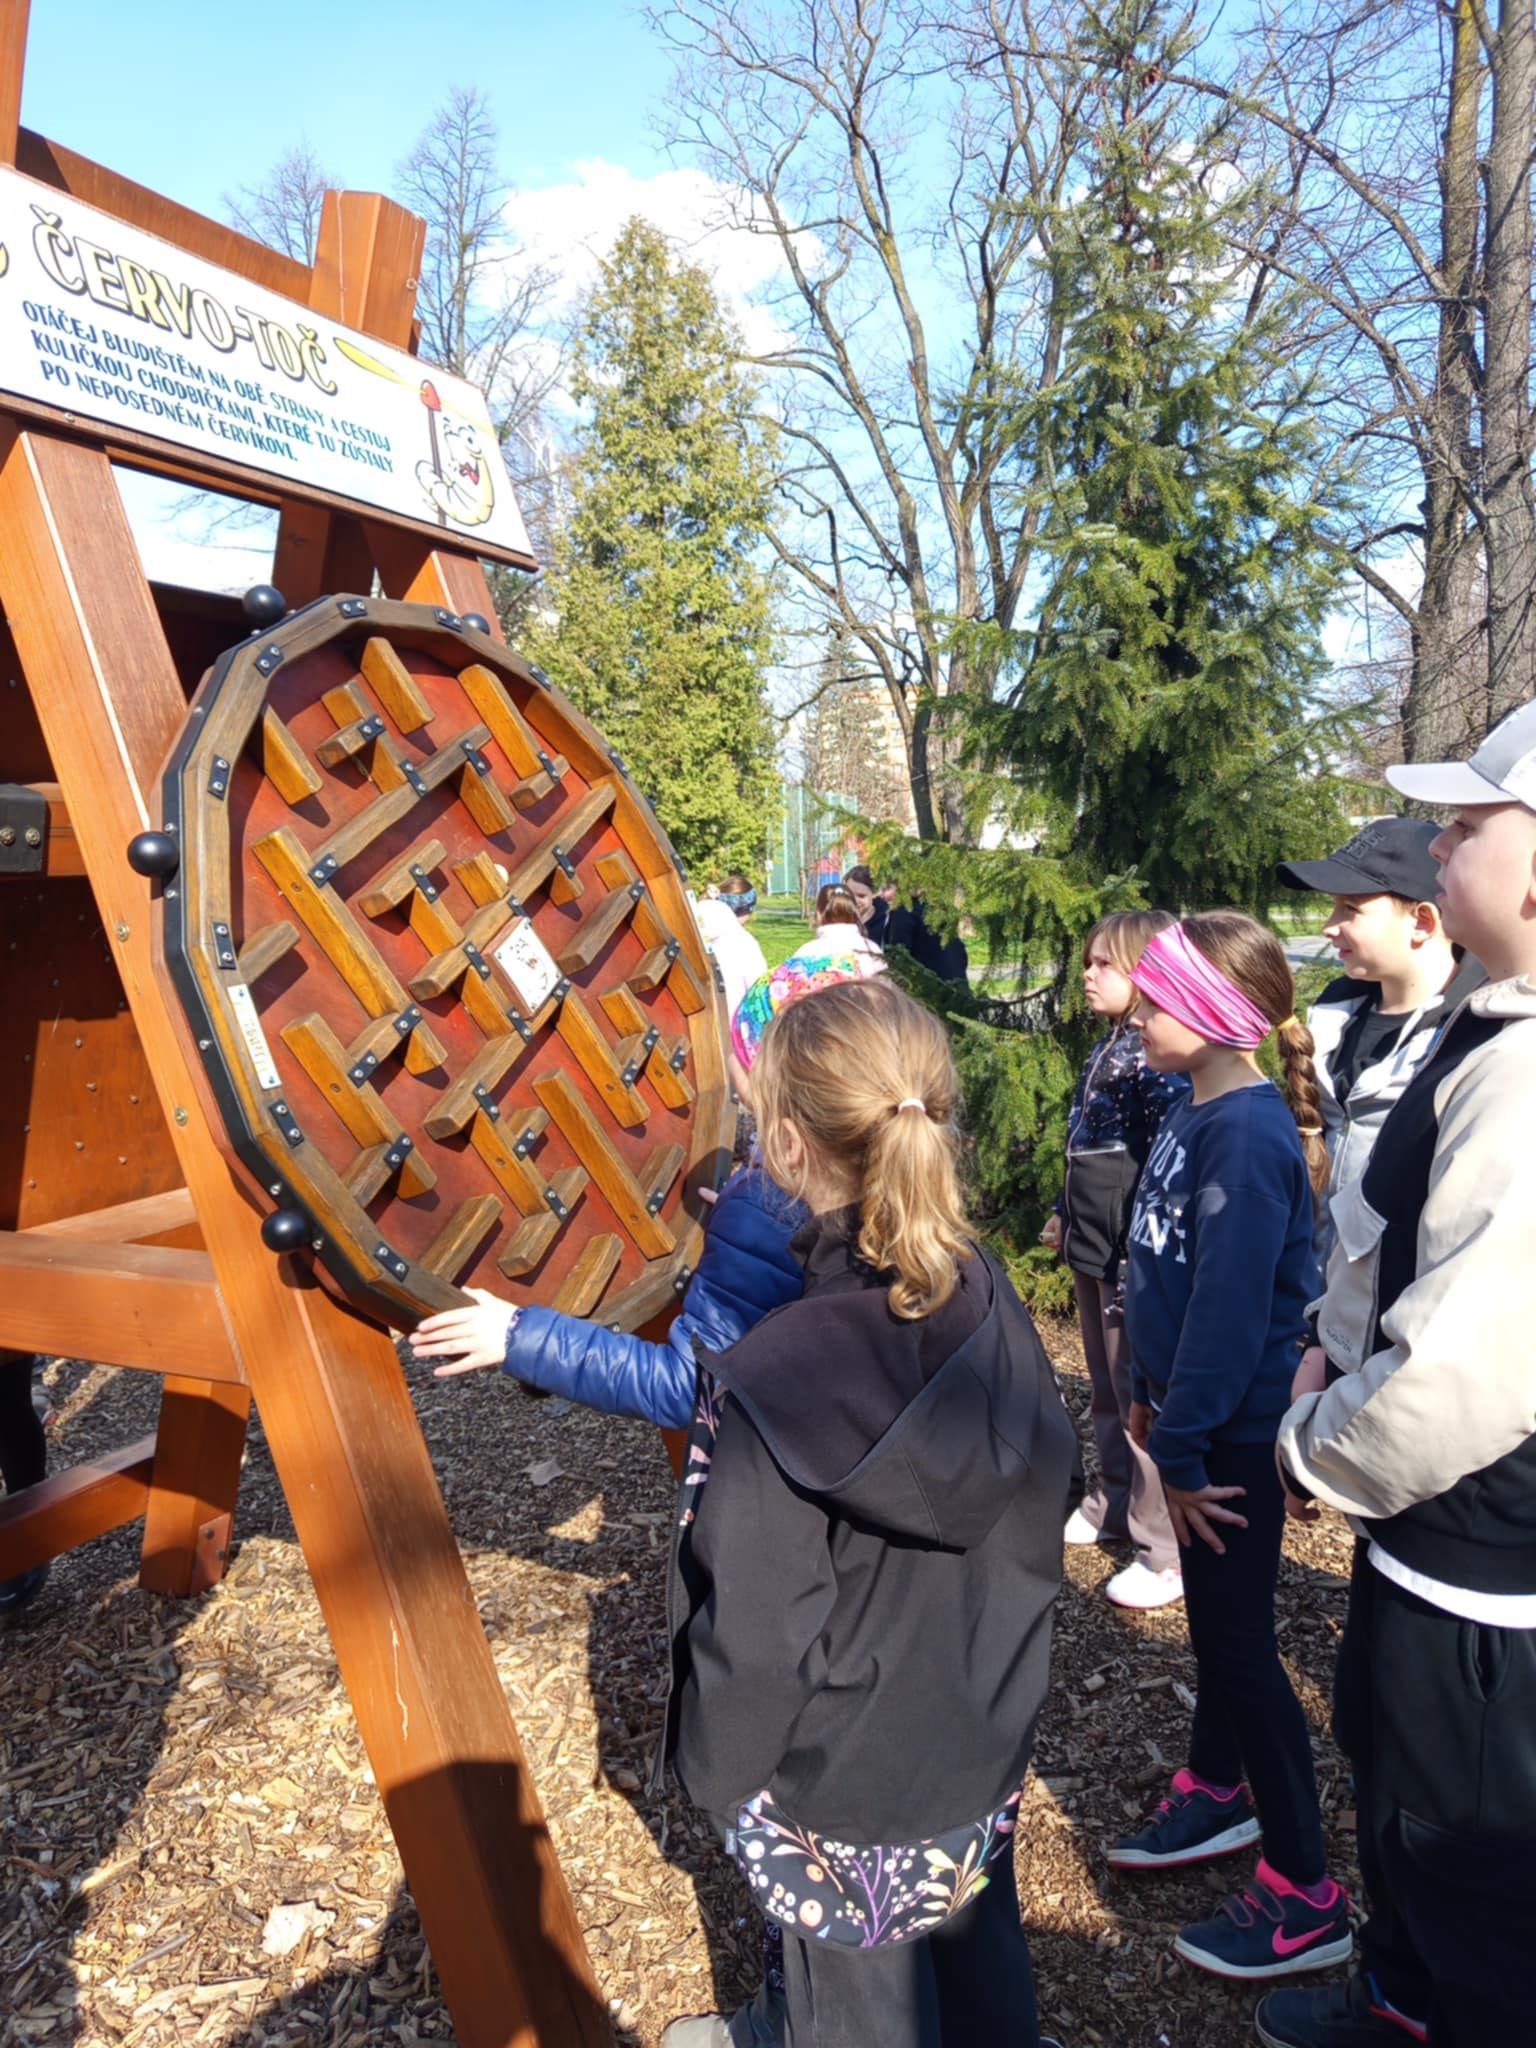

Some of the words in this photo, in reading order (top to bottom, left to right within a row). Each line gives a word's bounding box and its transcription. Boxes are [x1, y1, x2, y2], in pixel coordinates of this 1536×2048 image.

[29, 203, 338, 396] ČERVO-TOČ
[22, 300, 98, 344] OTÁČEJ
[102, 329, 206, 383] BLUDIŠTĚM
[208, 368, 231, 393] NA
[234, 379, 268, 406] OBĚ
[269, 391, 325, 427] STRANY
[341, 419, 391, 452] CESTUJ
[31, 328, 133, 382] KULIČKOU
[137, 368, 262, 429] CHODBIČKAMI,
[263, 411, 314, 445] KTERÉ
[316, 430, 336, 452] TU
[40, 358, 70, 387] PO
[75, 371, 205, 431] NEPOSEDNÉM
